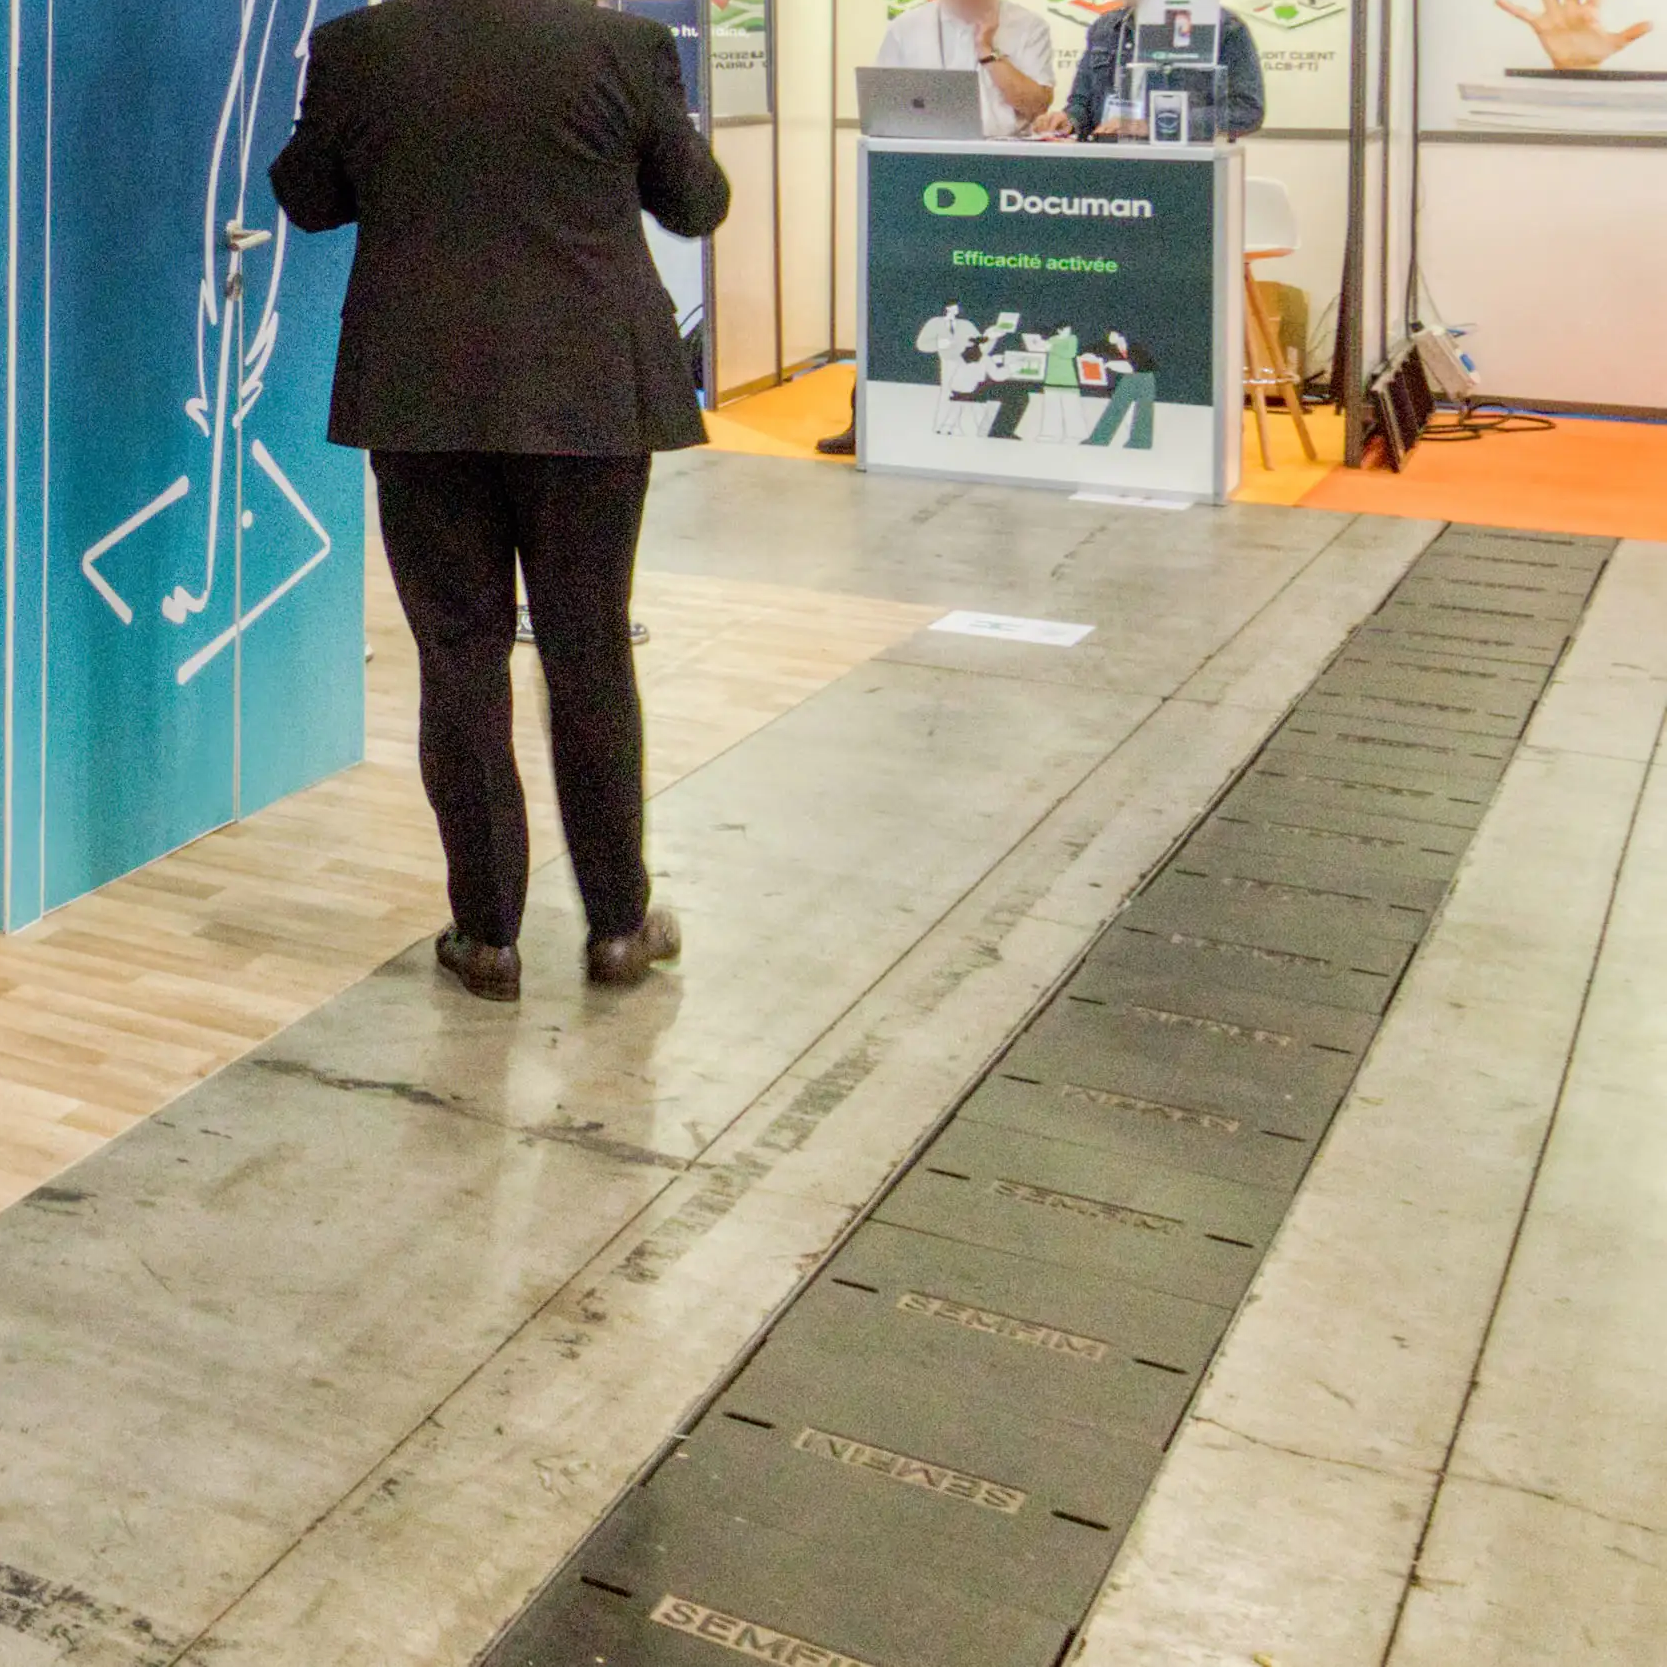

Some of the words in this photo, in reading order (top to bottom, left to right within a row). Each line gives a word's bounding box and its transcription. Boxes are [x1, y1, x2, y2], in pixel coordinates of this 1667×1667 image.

[1288, 50, 1337, 62] CLIENT
[999, 189, 1153, 219] Documan
[952, 248, 1042, 270] Efficacité
[1046, 253, 1119, 274] activée
